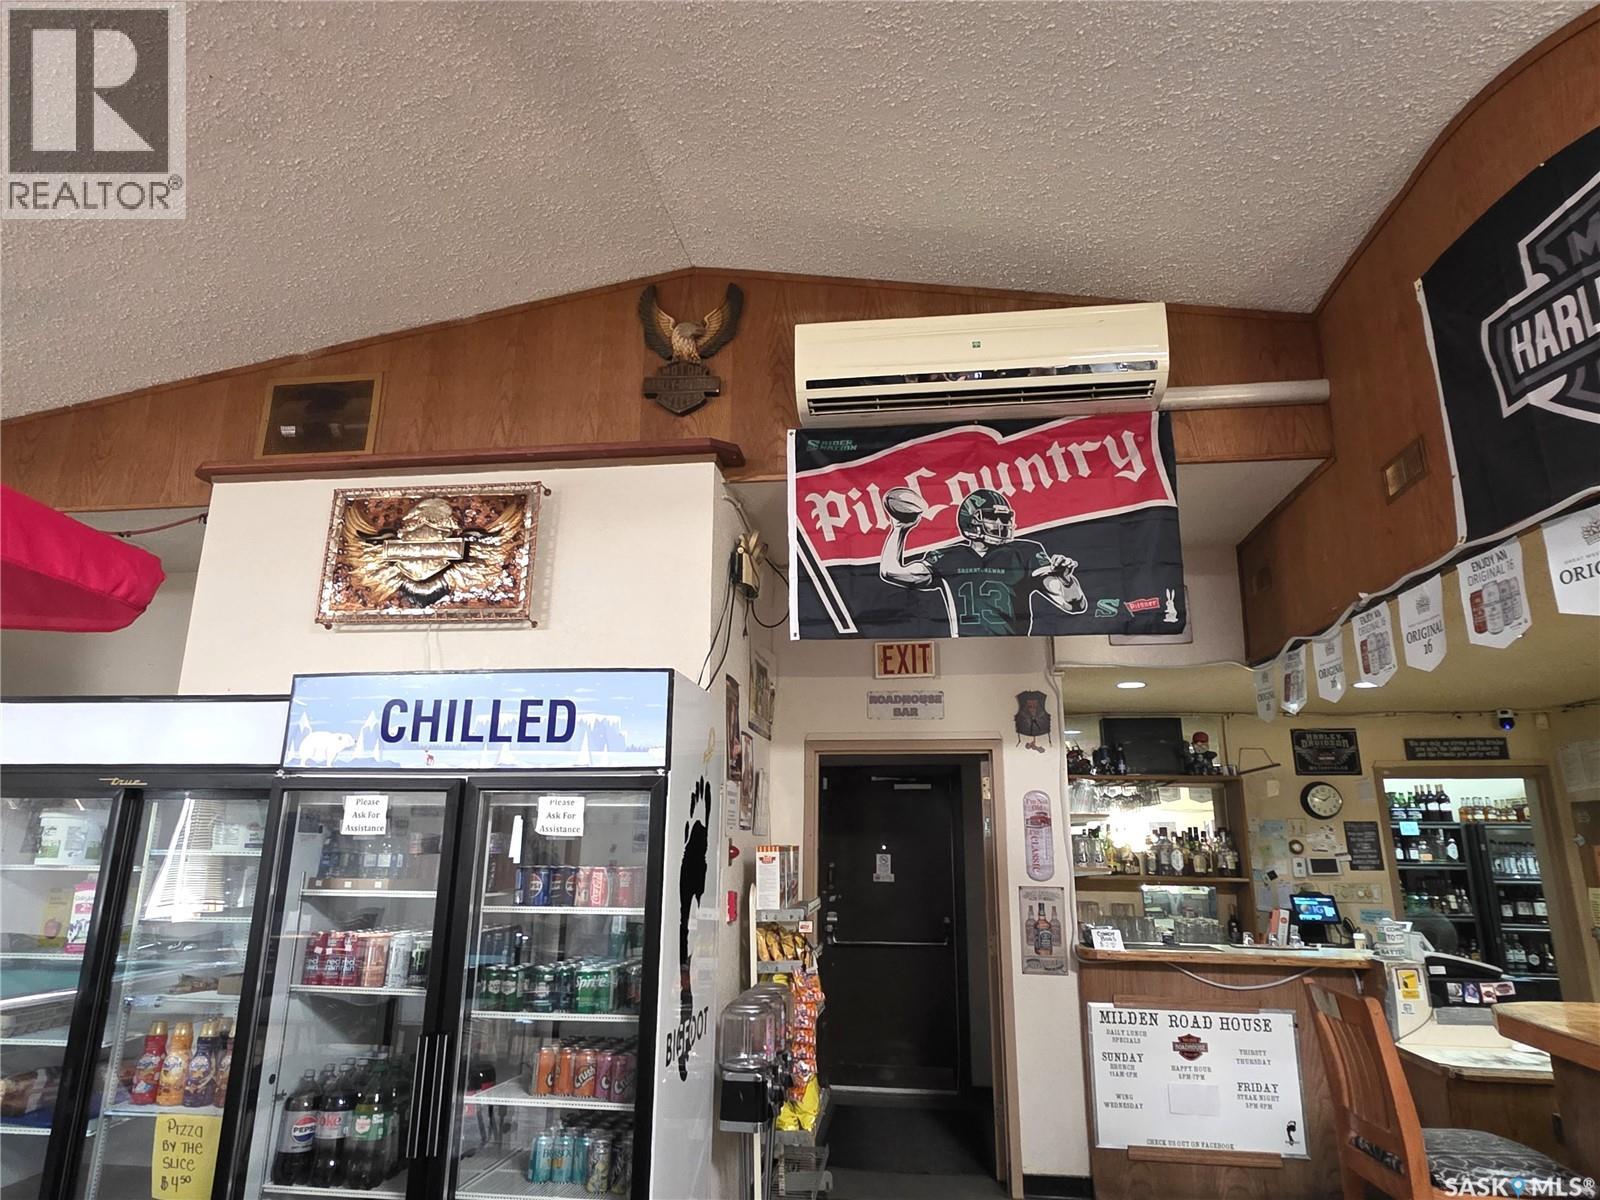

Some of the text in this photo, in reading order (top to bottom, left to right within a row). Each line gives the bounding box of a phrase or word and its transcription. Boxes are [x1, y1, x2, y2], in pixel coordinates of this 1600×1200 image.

[1511, 279, 1600, 375] HARL
[903, 430, 1146, 521] Country
[1471, 554, 1495, 572] ENJOY
[1467, 566, 1506, 586] ORIGINAL
[1406, 621, 1444, 645] ORIGINAL
[1424, 639, 1434, 655] 16
[883, 644, 930, 675] EXIT
[893, 707, 919, 717] BAR
[380, 698, 577, 743] CHILLED
[352, 812, 380, 820] Ask For
[546, 812, 576, 820] Ask For
[345, 824, 385, 833] Assistance
[539, 826, 581, 834] Assistance
[1099, 1010, 1272, 1032] MILDEN ROAD HOUSE
[1102, 1052, 1144, 1062] SUNDAY
[1236, 1058, 1272, 1066] THURSDAY
[1237, 1082, 1279, 1093] FRIDAY
[1104, 1102, 1144, 1110] WEDNESDAY
[162, 1139, 177, 1152] BY
[1146, 1138, 1166, 1146] CHECK
[1200, 1142, 1234, 1150] FACEBOOK
